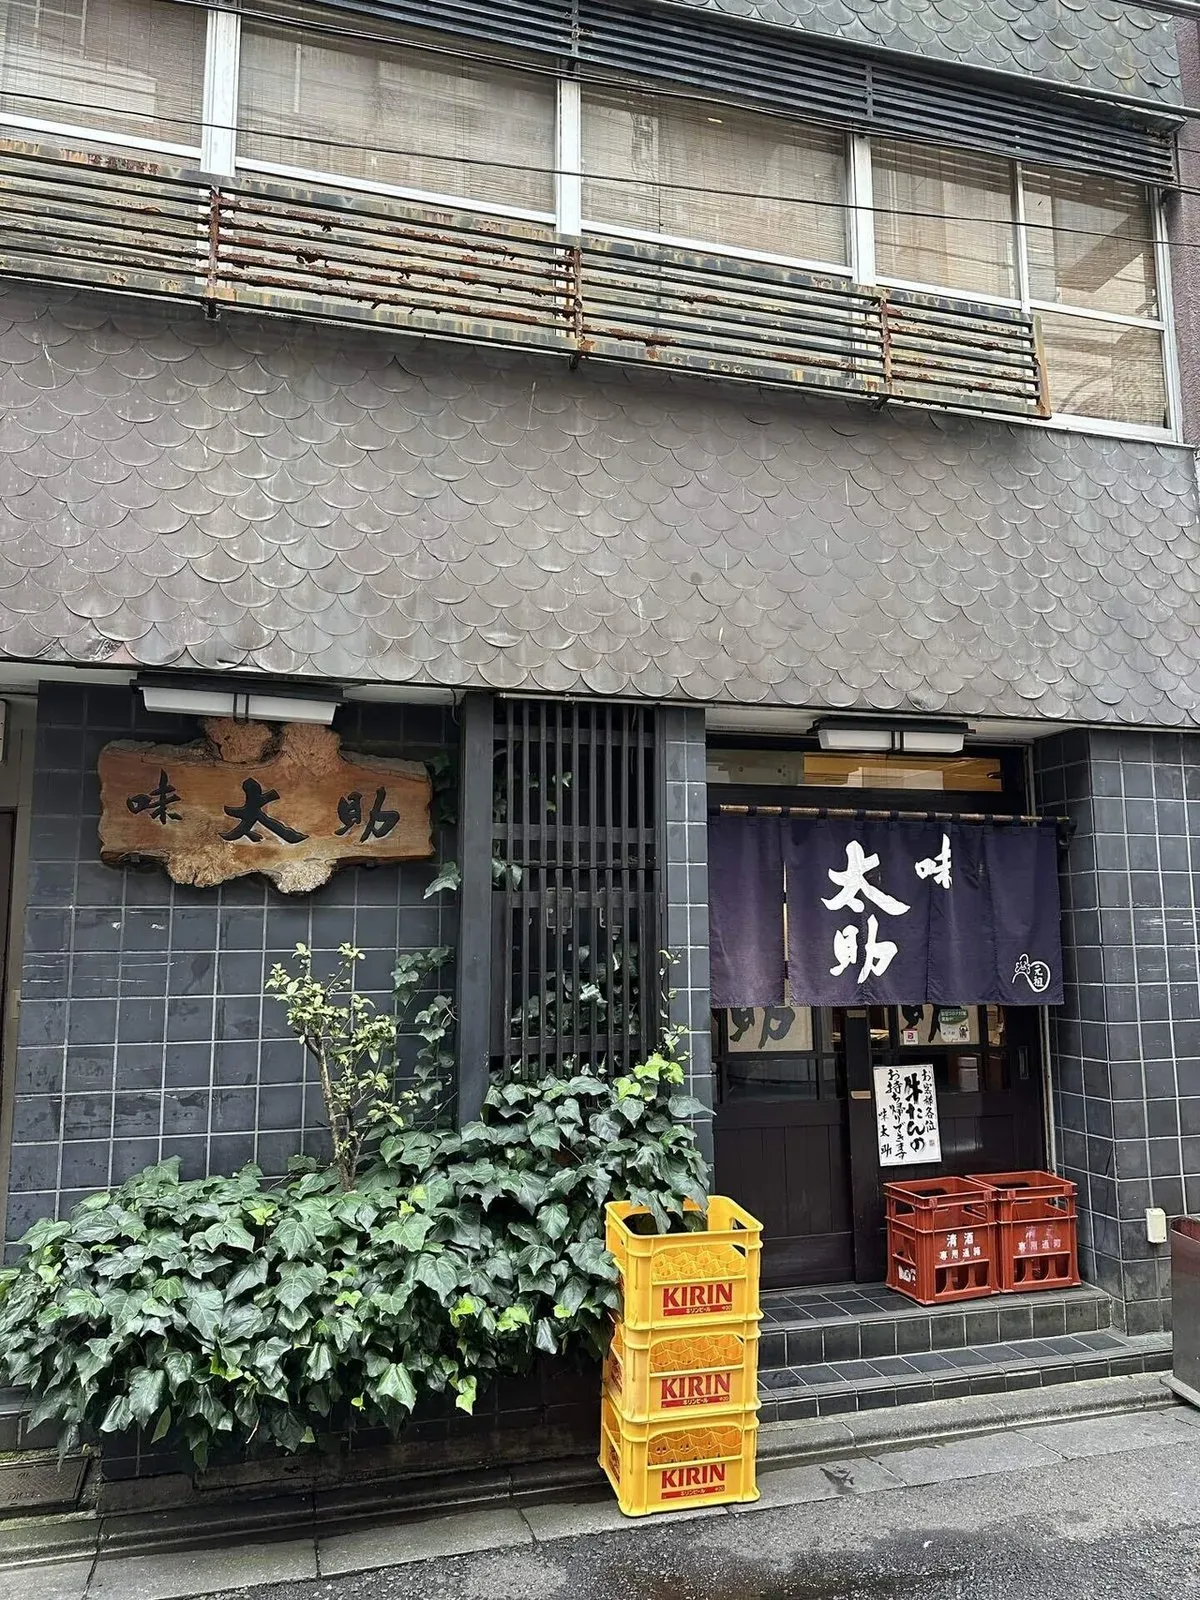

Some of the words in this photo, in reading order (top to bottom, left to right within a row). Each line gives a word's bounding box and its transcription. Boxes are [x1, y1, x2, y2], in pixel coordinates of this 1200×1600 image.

[127, 768, 400, 844] 味太助
[915, 833, 953, 889] 味
[821, 840, 911, 984] 太助
[1033, 964, 1044, 988] 元祖
[904, 1073, 925, 1152] 牛たんの
[946, 1231, 974, 1248] 清酒
[662, 1283, 732, 1308] KIRIN
[661, 1372, 731, 1400] KIRIN
[661, 1463, 726, 1489] KIRIN
